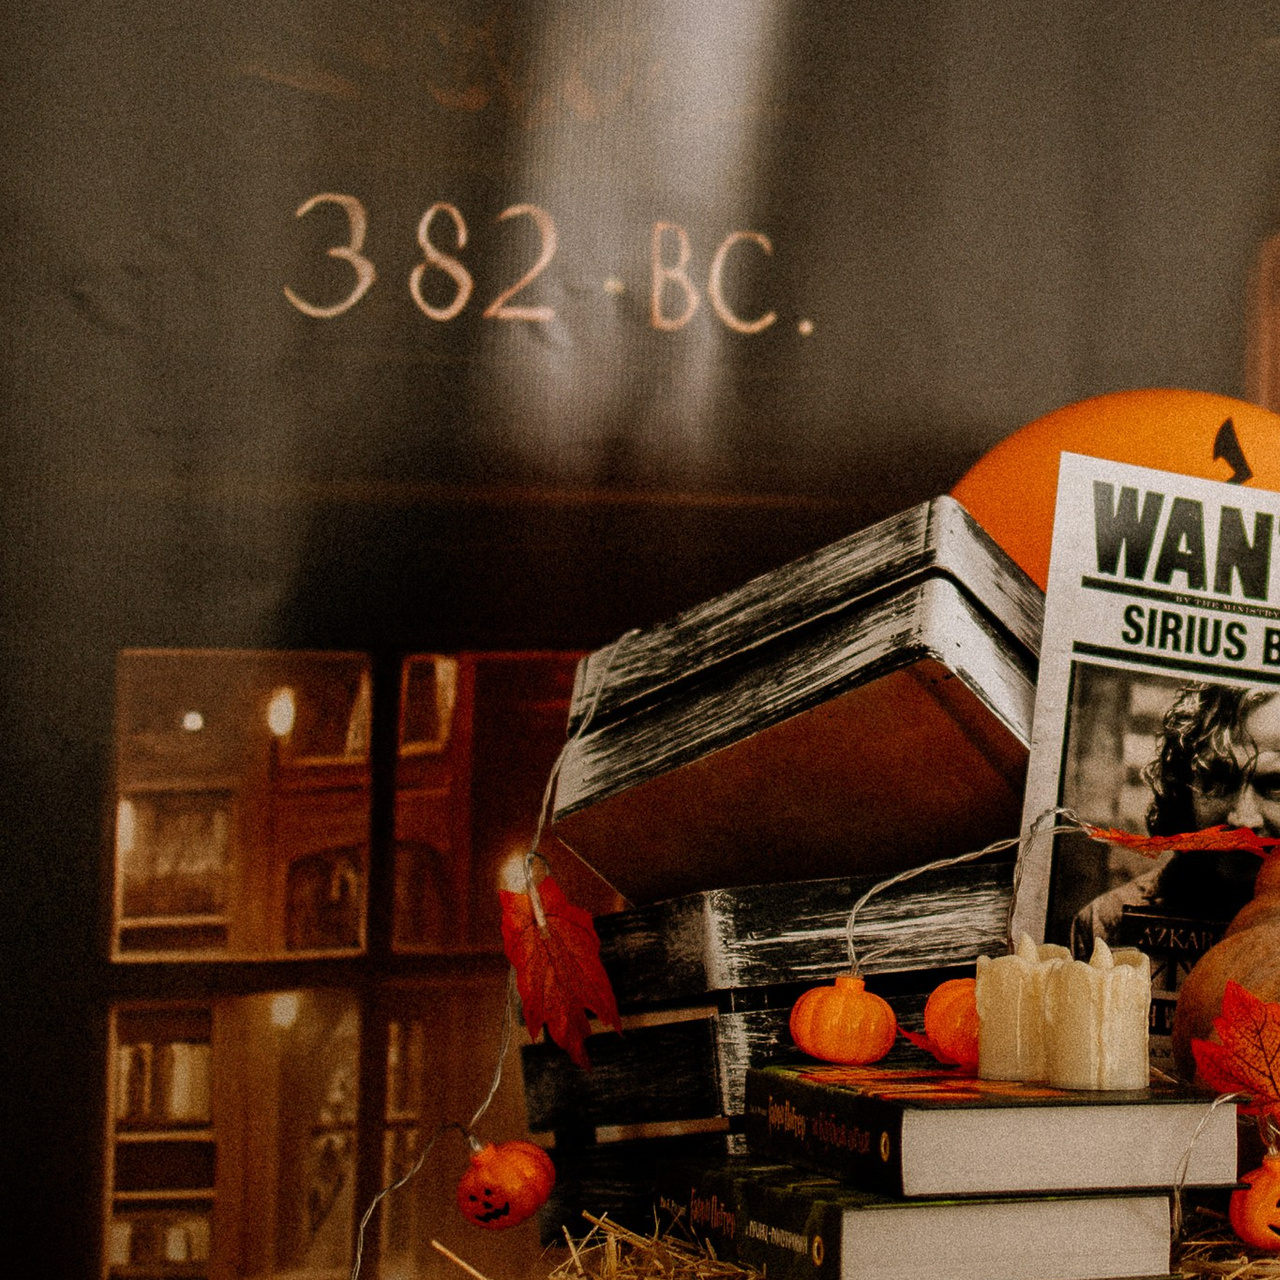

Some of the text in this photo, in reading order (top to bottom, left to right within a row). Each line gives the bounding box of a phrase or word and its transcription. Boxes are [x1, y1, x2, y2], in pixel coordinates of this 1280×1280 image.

[284, 191, 558, 322] 382
[1122, 604, 1248, 662] SIRIUS
[1176, 596, 1191, 604] BY
[1194, 598, 1219, 609] THE
[1222, 603, 1280, 620] MINISTRY
